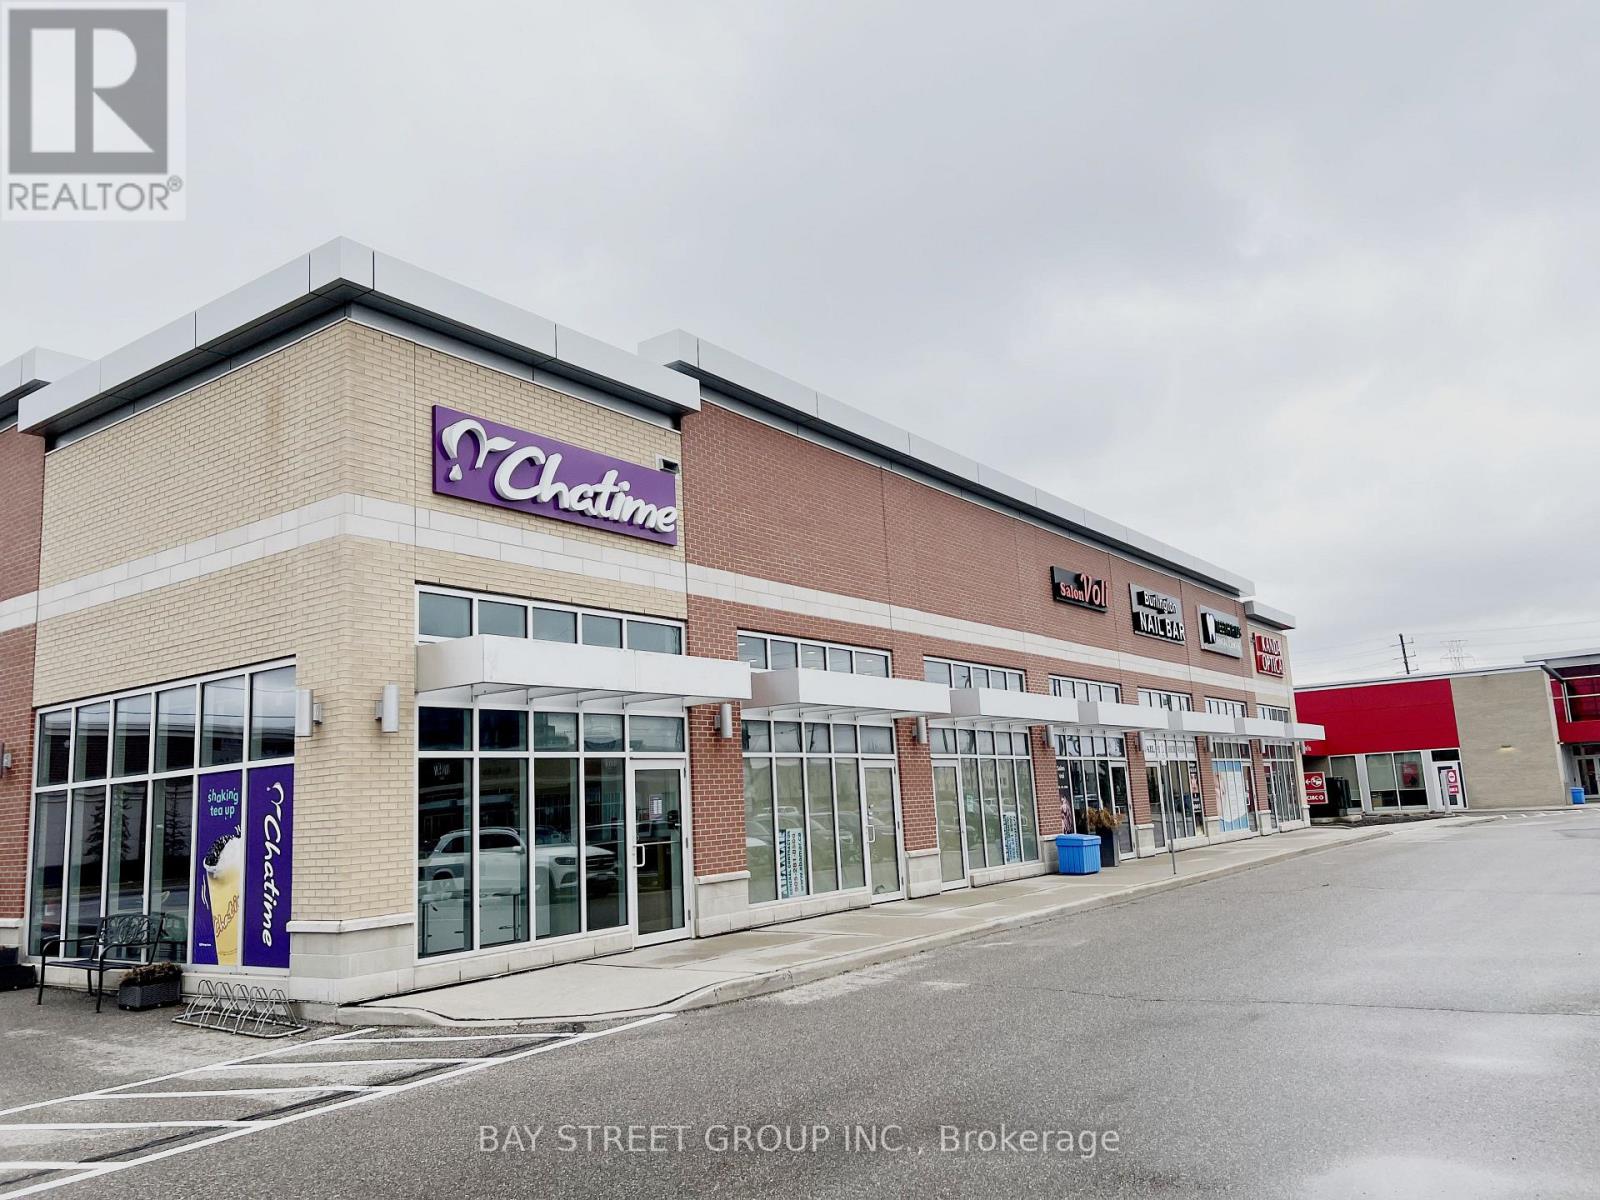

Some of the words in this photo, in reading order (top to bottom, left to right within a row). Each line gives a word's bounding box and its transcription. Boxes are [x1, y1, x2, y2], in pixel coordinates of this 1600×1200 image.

[494, 445, 678, 534] Chatime
[1060, 581, 1085, 602] Salon
[1080, 573, 1110, 607] Voli
[1144, 591, 1178, 614] Burlington
[1140, 611, 1165, 636] NAIL
[1165, 618, 1187, 641] BAR
[208, 787, 239, 805] shaking
[210, 805, 224, 817] tea
[224, 805, 236, 819] up
[262, 814, 281, 948] Chatime
